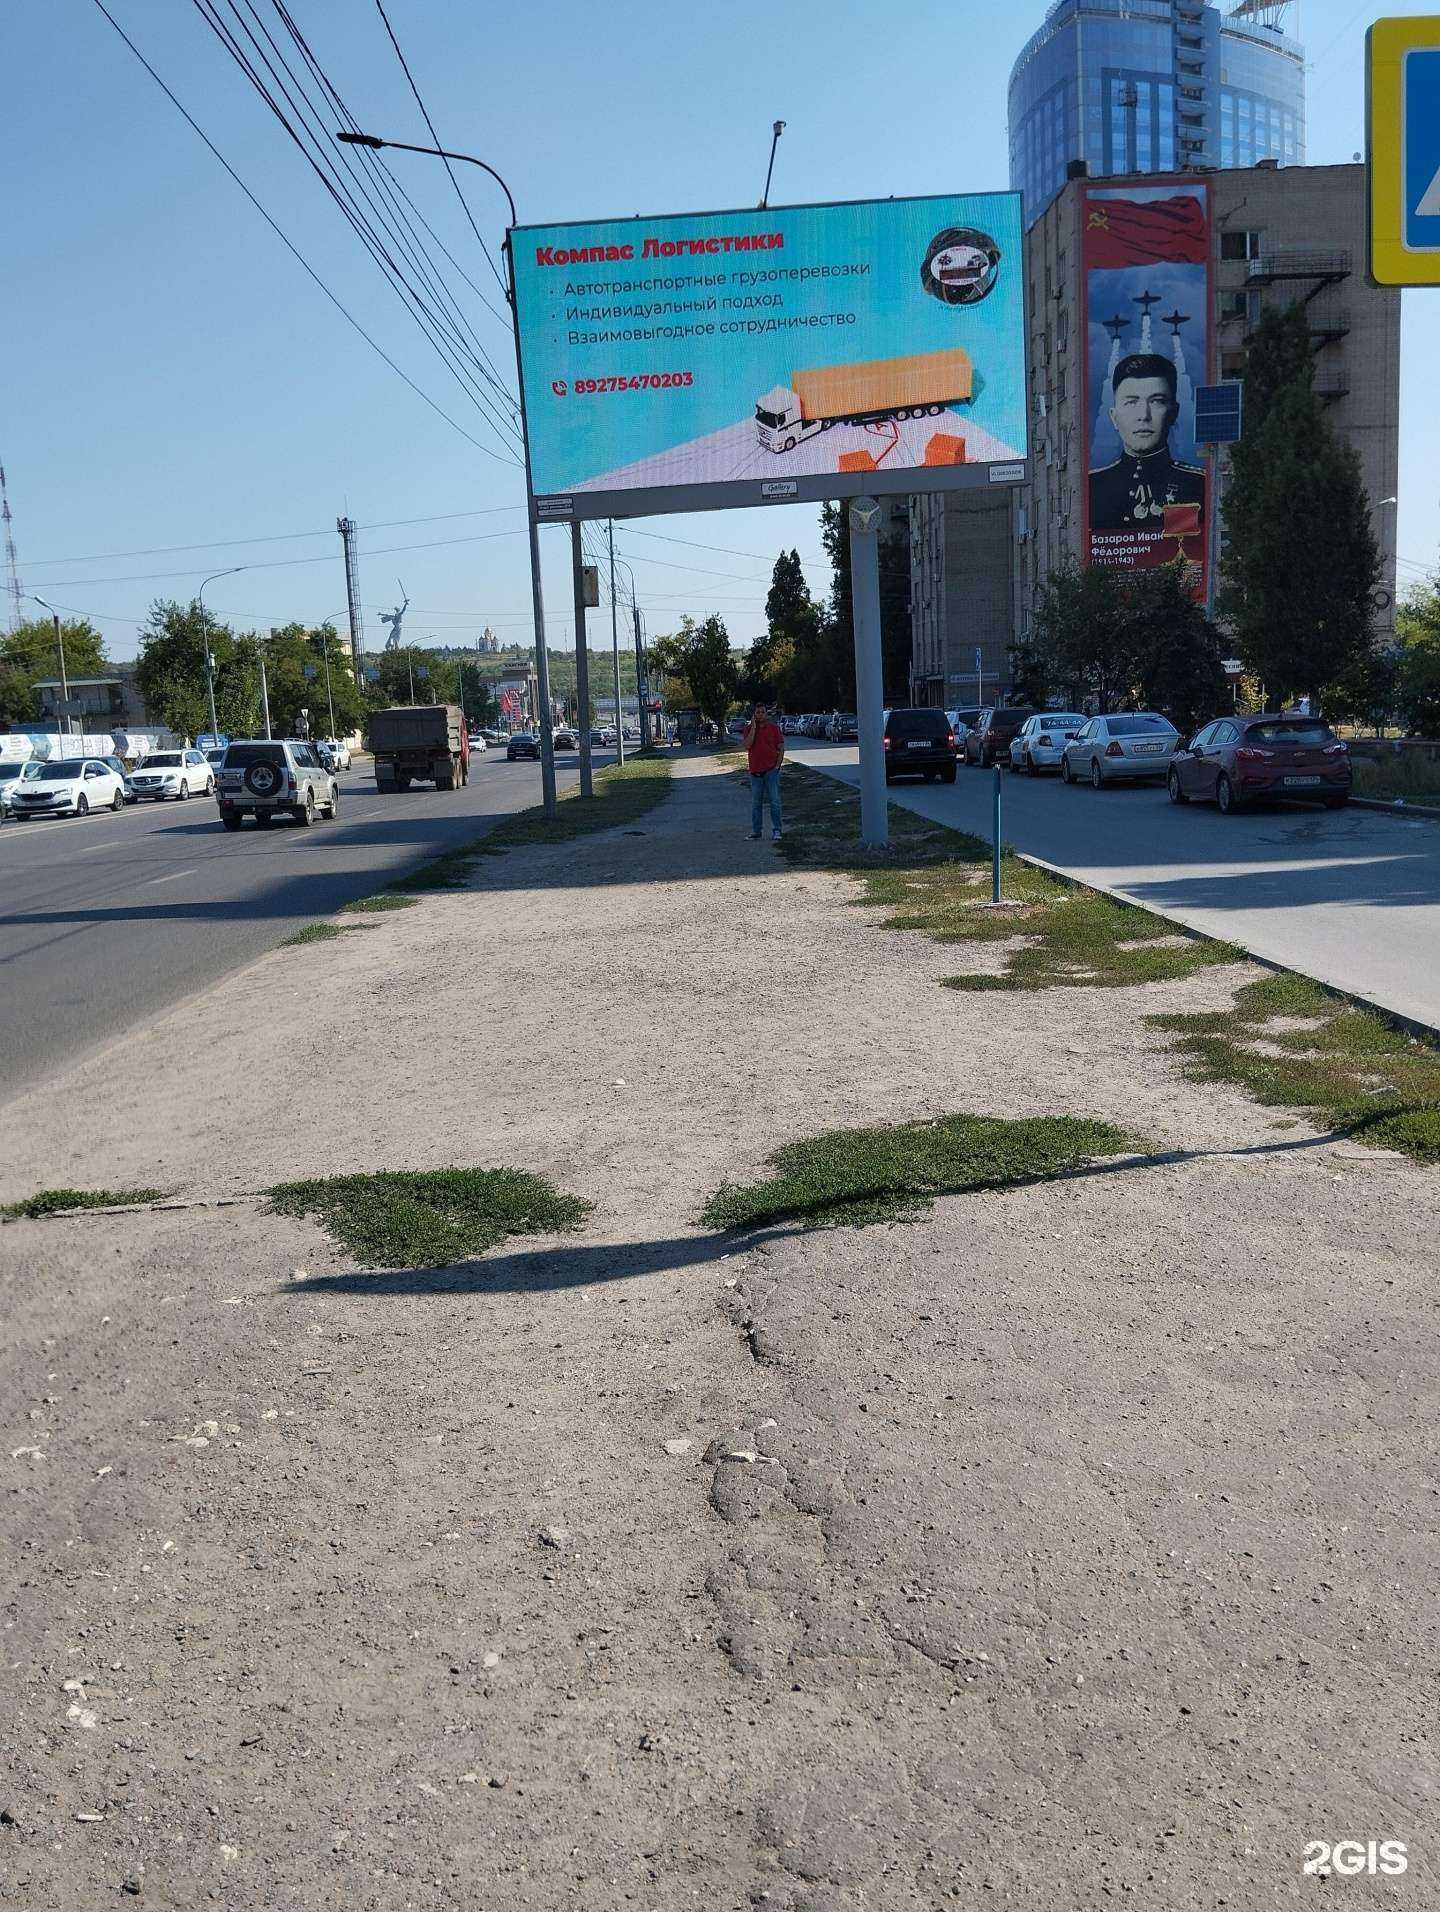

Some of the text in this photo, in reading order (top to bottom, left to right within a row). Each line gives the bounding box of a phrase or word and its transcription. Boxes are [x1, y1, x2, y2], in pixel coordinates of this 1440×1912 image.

[536, 233, 784, 266] Компас Логистики
[564, 263, 871, 296] Автотранспортные грузоперевозки
[566, 294, 784, 321] Индивидуальный подход
[568, 312, 856, 345] Взаимовыгодное сотрудничество
[574, 372, 694, 394] 89275470203
[1091, 531, 1164, 544] Базаров Иван
[1091, 546, 1151, 556] Фёдорович
